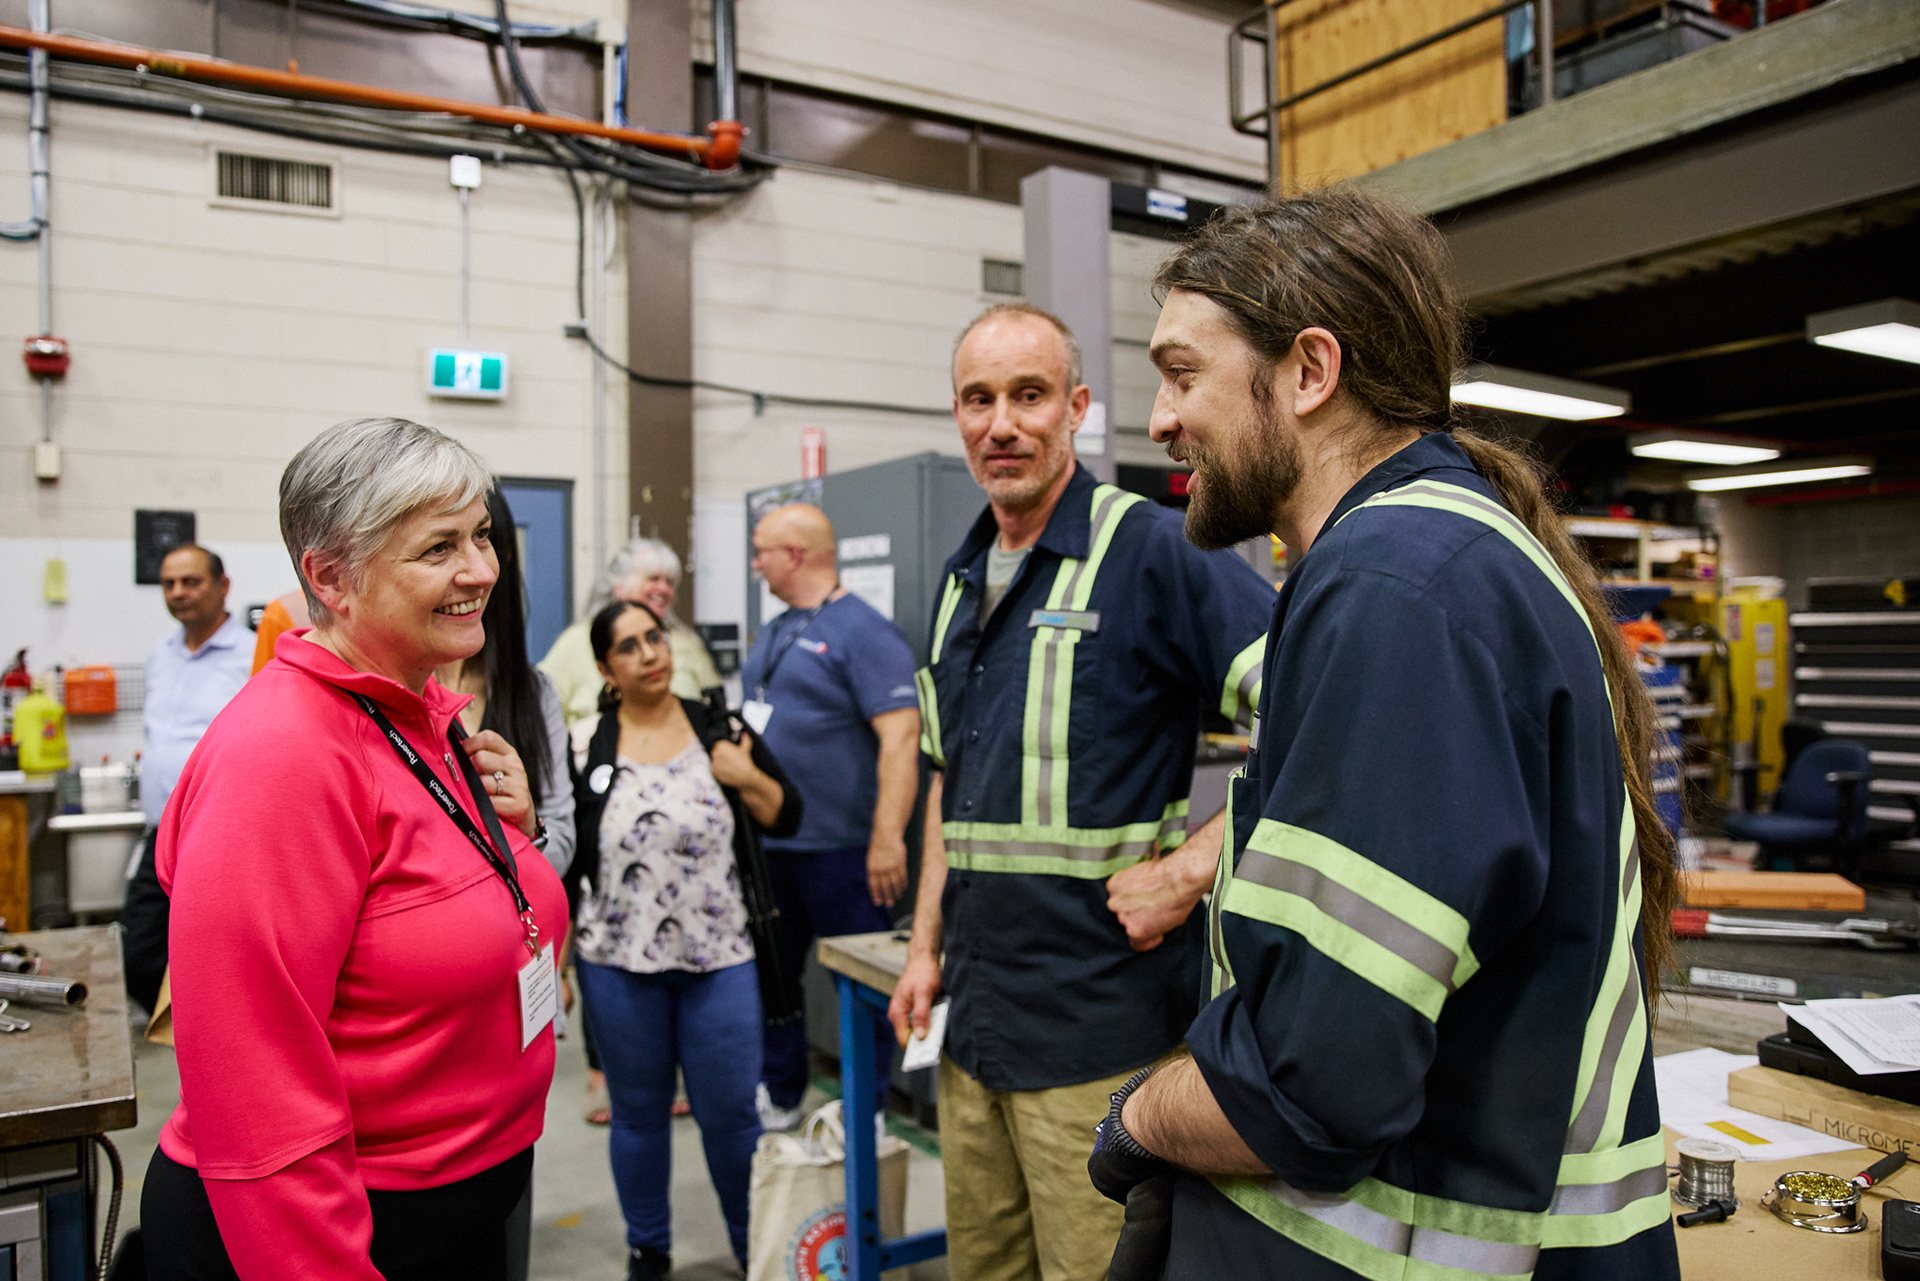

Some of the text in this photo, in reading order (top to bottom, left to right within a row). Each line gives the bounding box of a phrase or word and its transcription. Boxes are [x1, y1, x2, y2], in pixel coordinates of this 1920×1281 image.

[389, 730, 418, 765] Powertech
[429, 780, 457, 814] Powertech
[1825, 1117, 1920, 1154] MICROME
